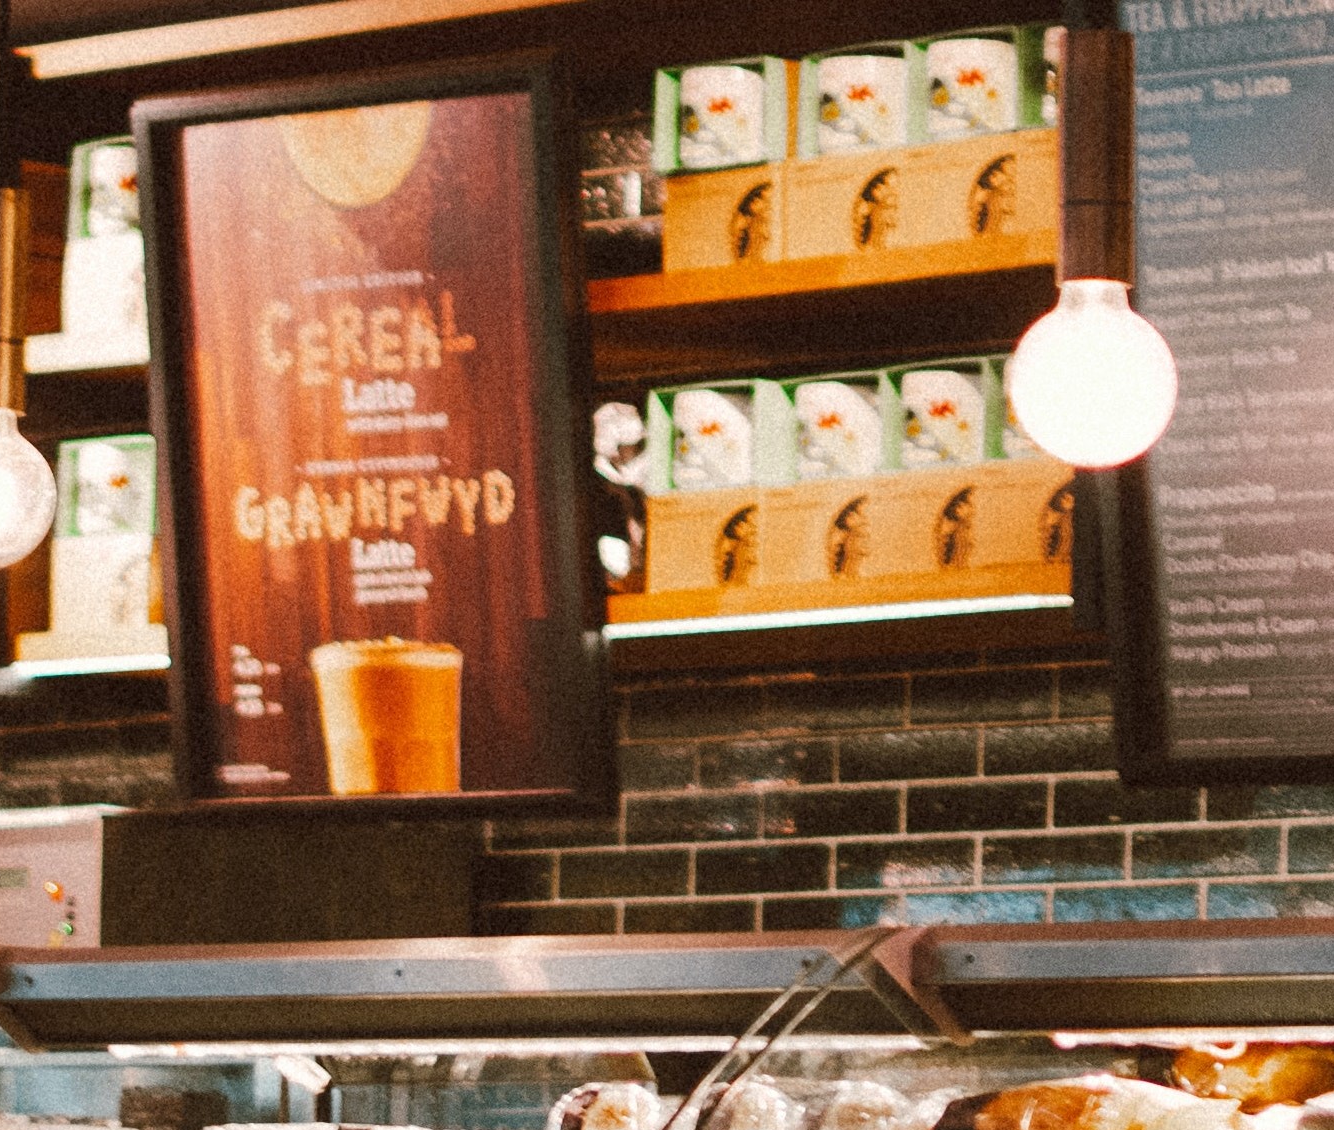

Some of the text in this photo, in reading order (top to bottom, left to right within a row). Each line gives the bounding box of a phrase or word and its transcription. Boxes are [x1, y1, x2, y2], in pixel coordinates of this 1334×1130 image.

[257, 290, 477, 385] CEREAL
[340, 378, 417, 413] Latte
[234, 468, 516, 550] GRAWNFWYD
[350, 537, 416, 570] Latte
